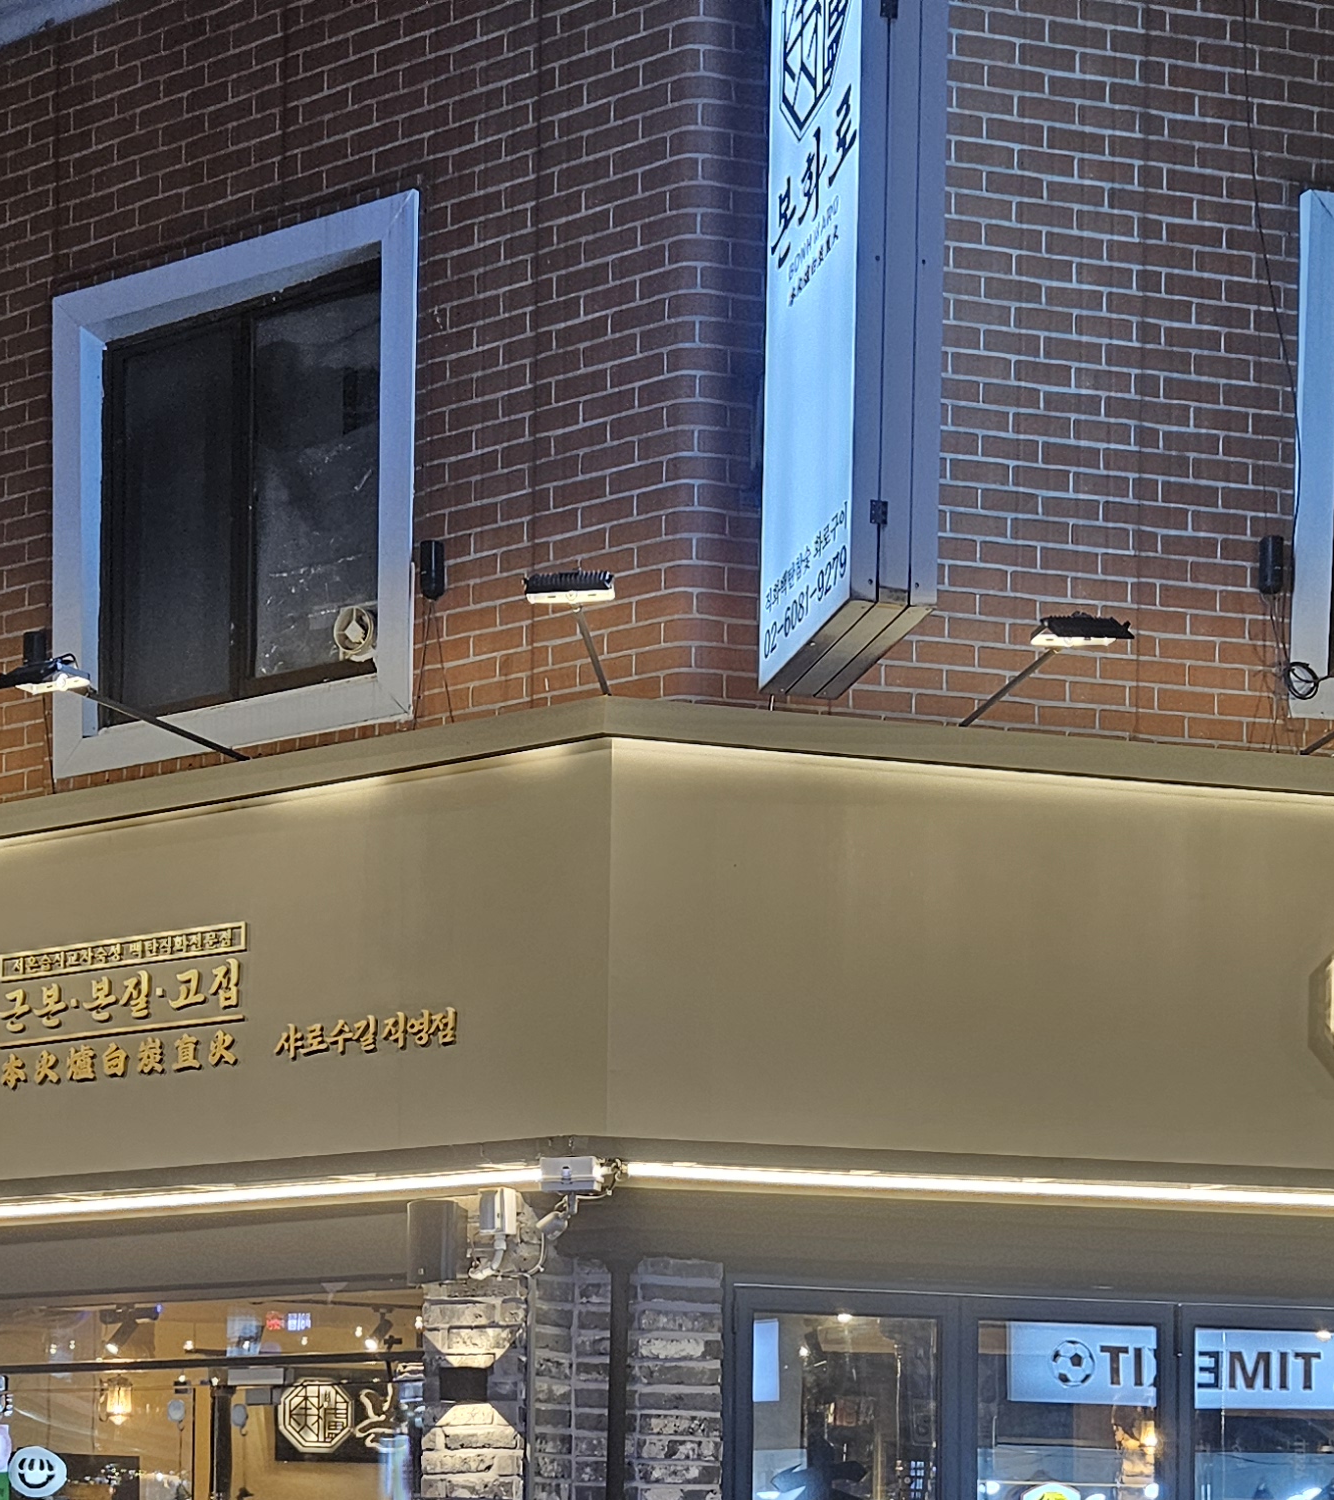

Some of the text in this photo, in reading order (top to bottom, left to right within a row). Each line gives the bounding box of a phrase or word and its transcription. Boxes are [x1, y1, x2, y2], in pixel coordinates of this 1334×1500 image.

[763, 543, 848, 660] 02-6081-9279
[274, 1007, 458, 1059] 샤로수길 직영점
